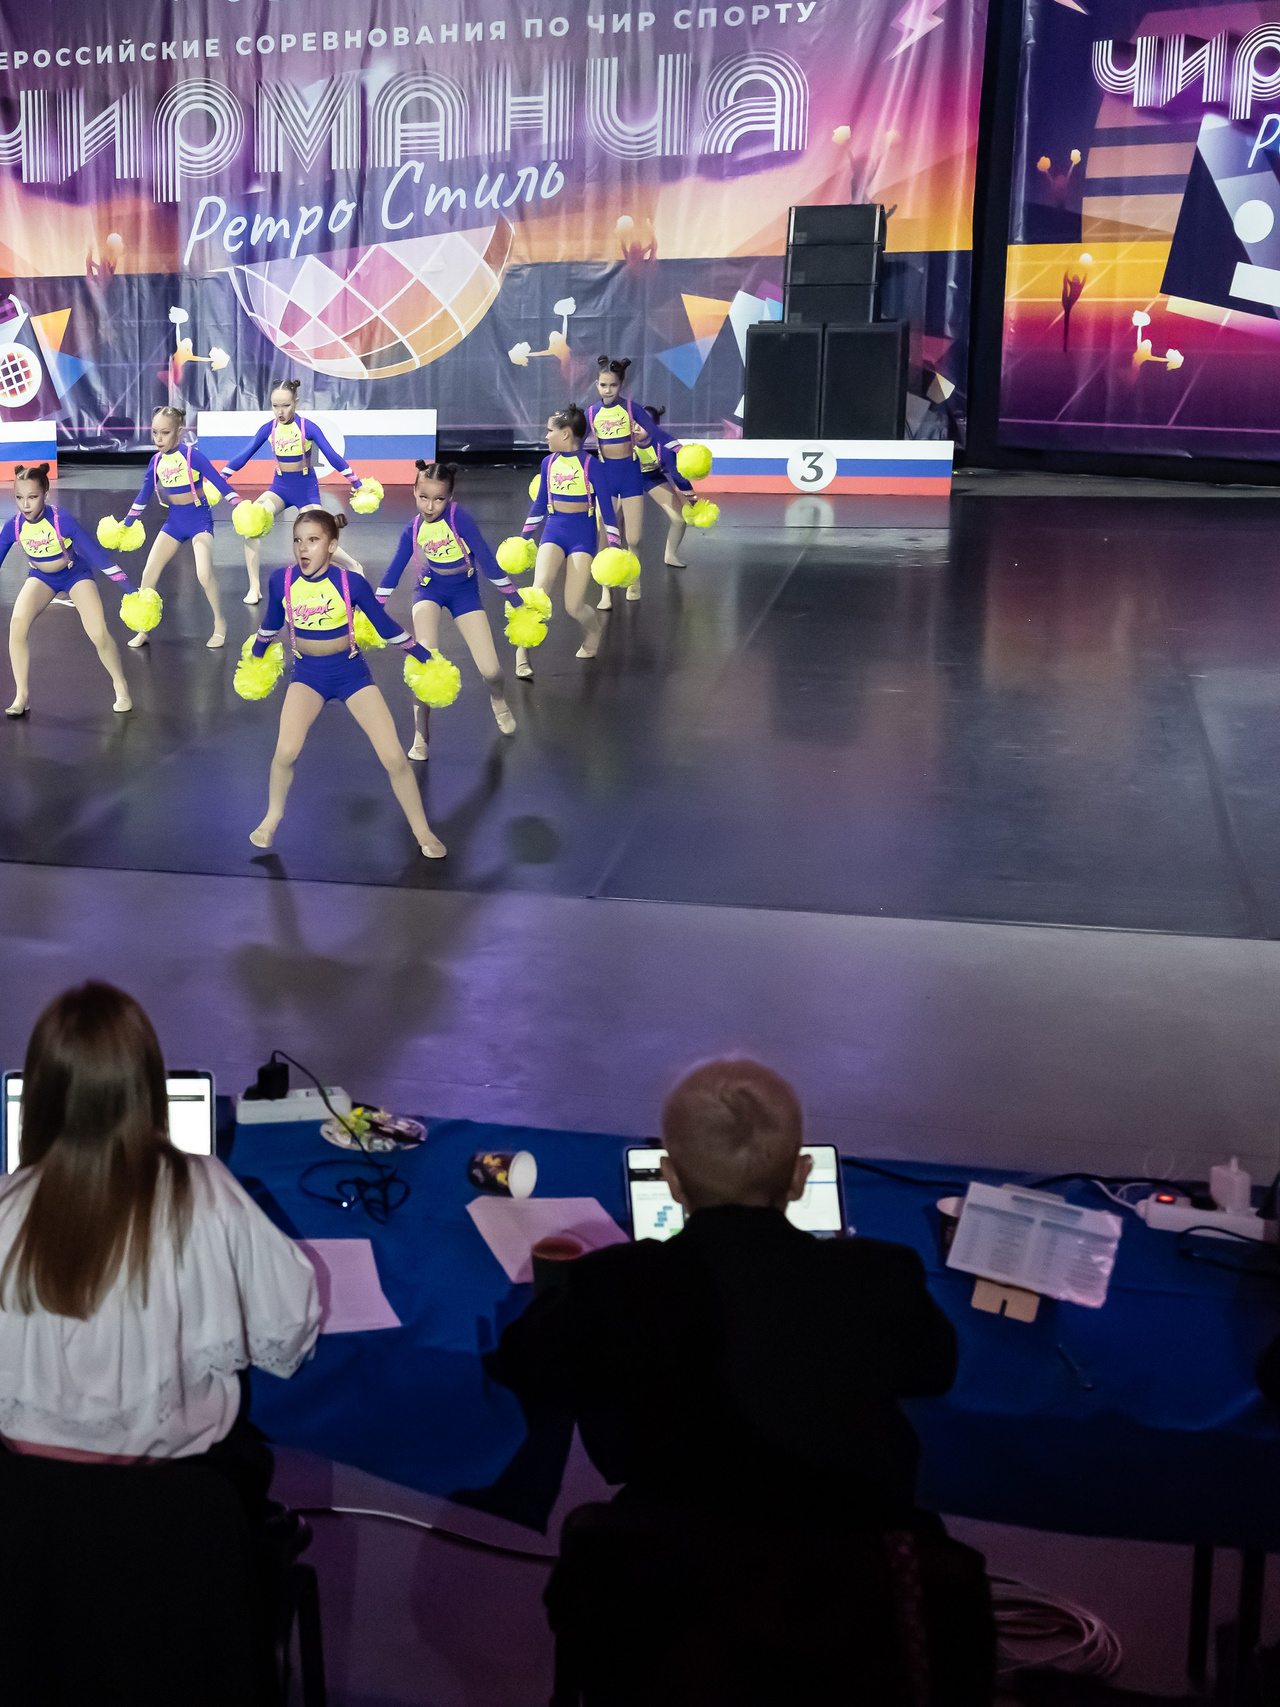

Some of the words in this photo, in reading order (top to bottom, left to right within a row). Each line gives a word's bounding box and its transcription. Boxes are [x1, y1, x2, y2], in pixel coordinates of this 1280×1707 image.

[235, 20, 506, 56] СОРЕВНОВАНИЯ
[524, 16, 569, 39] ПО
[588, 11, 656, 34] ЧИР
[673, 1, 817, 30] СПОРТУ
[183, 195, 357, 267] Ретро
[380, 160, 565, 230] Стиль
[800, 451, 825, 483] 3
